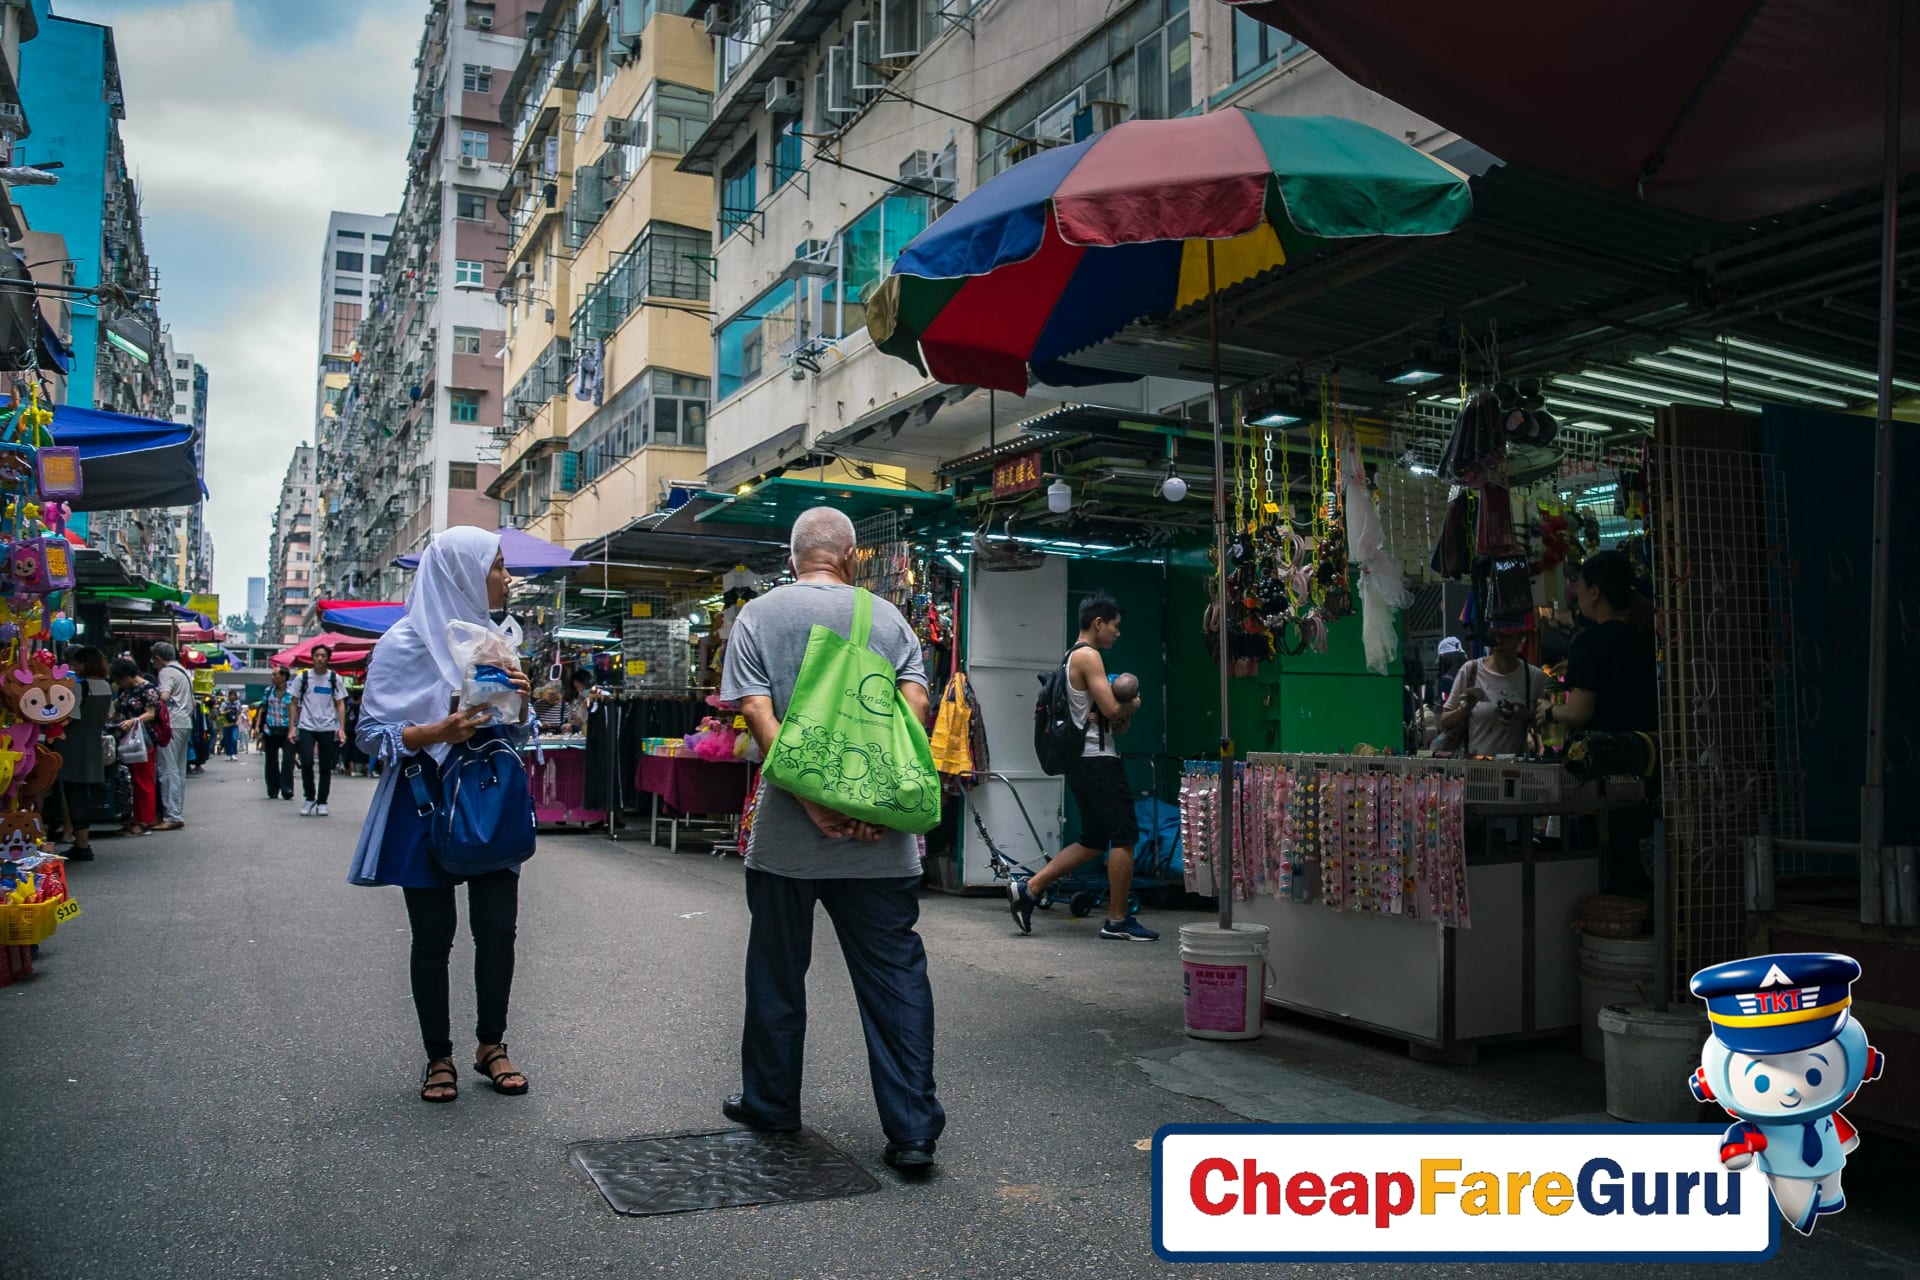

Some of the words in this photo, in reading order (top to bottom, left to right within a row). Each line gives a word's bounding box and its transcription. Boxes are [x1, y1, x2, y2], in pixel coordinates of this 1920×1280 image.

[844, 688, 874, 702] Green
[875, 697, 892, 709] dot
[57, 902, 78, 920] $10
